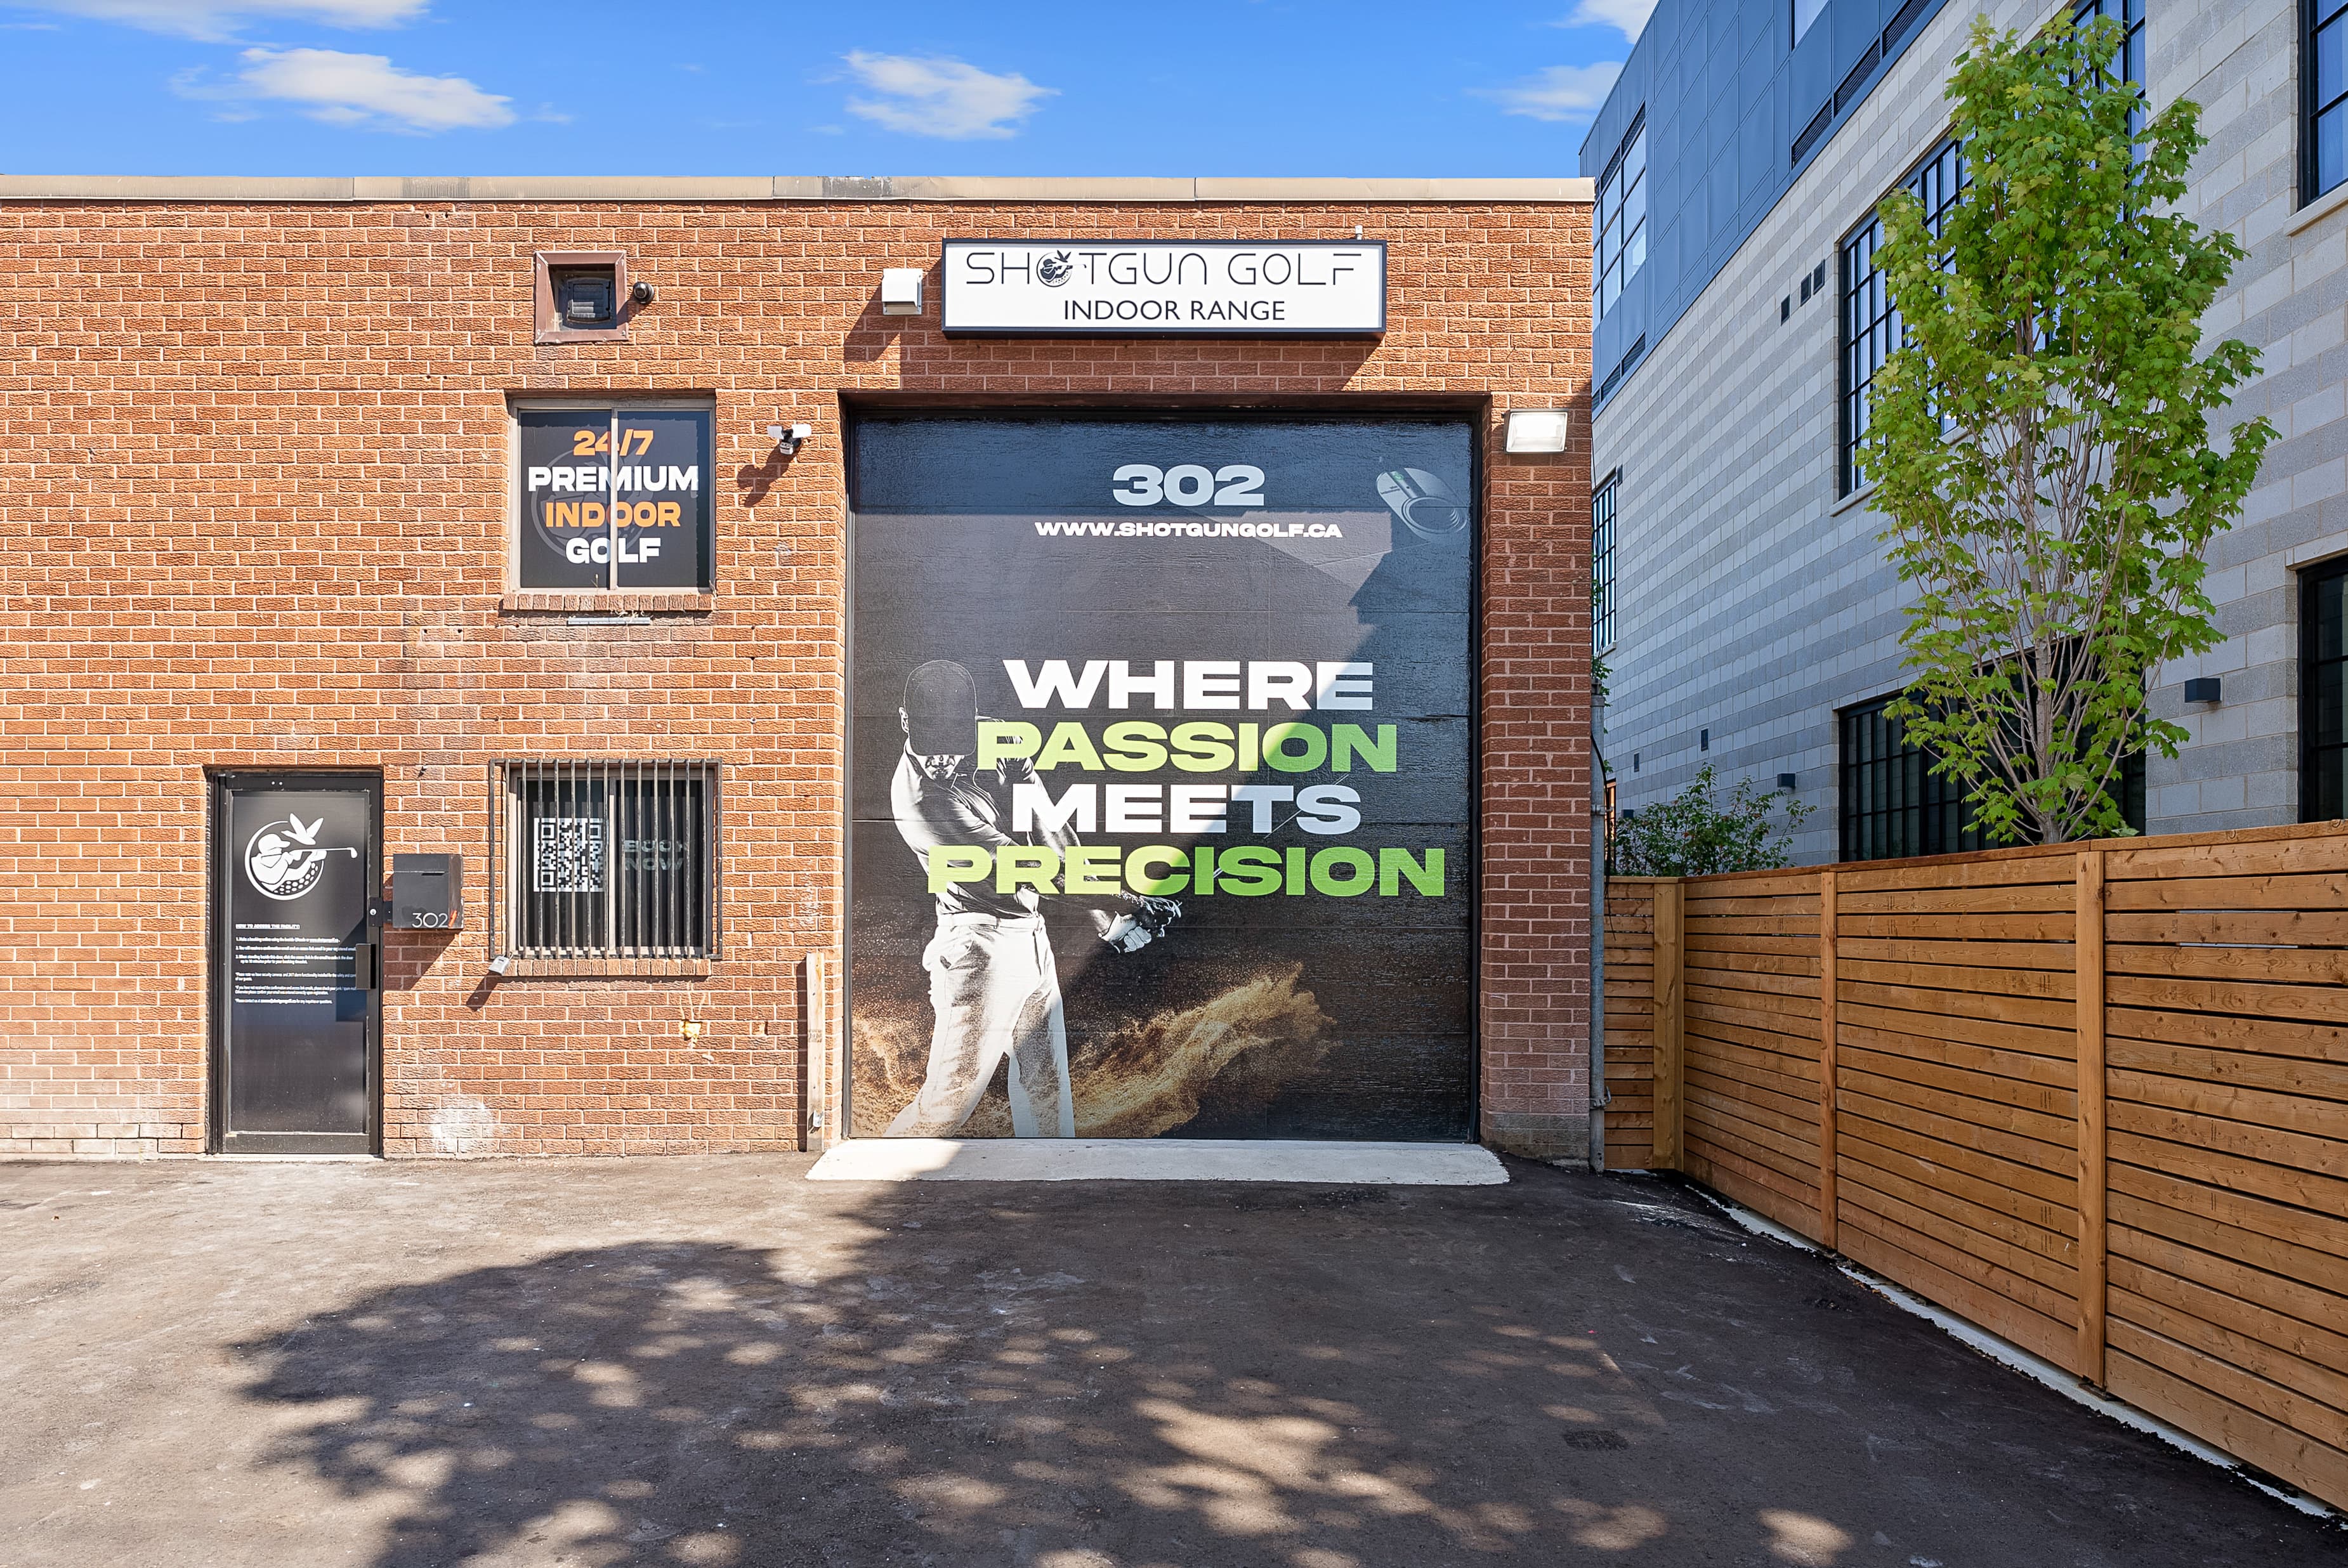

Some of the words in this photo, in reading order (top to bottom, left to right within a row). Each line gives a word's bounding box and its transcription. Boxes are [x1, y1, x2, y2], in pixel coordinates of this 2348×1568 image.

[1228, 253, 1362, 285] GOLF
[1065, 301, 1181, 321] INDOOR
[1191, 301, 1285, 321] RANGE
[573, 429, 654, 457] 24/7
[528, 466, 699, 492] PREMIUM
[1112, 464, 1265, 507] 302
[545, 501, 681, 528] INDOOR
[1035, 522, 1343, 539] WWW.SHOTGUNGOLF.CA
[565, 537, 661, 564] GOLF
[1003, 660, 1373, 710] WHERE
[978, 721, 1397, 773] PASSION
[1013, 784, 1361, 834] MEETS
[928, 845, 1445, 897] PRECISION
[412, 912, 449, 927] 302
